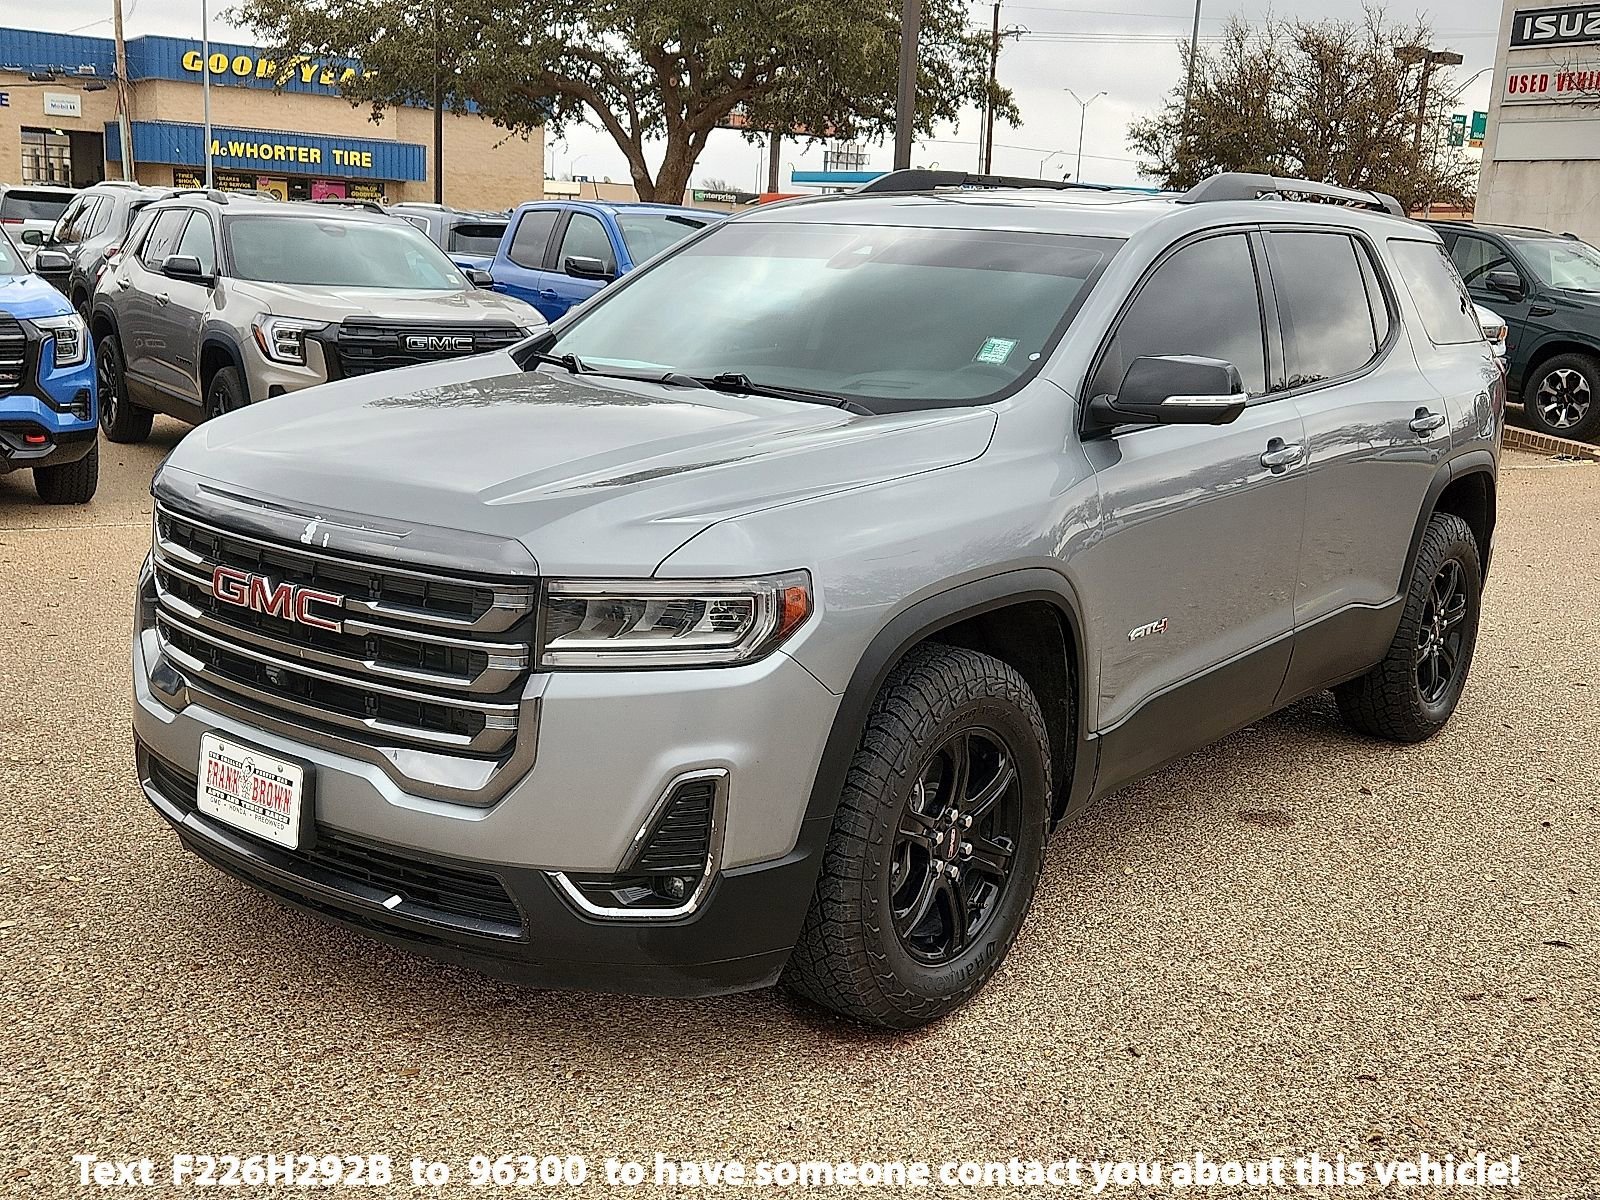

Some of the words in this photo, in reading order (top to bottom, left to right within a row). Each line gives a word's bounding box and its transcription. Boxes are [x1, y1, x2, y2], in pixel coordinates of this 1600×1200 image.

[1508, 74, 1549, 94] USED
[332, 149, 372, 167] TIRE
[696, 191, 737, 202] enterprise
[406, 336, 473, 351] GMC
[213, 565, 344, 634] GMC
[207, 759, 240, 795] FRANK
[252, 776, 292, 815] BROWN
